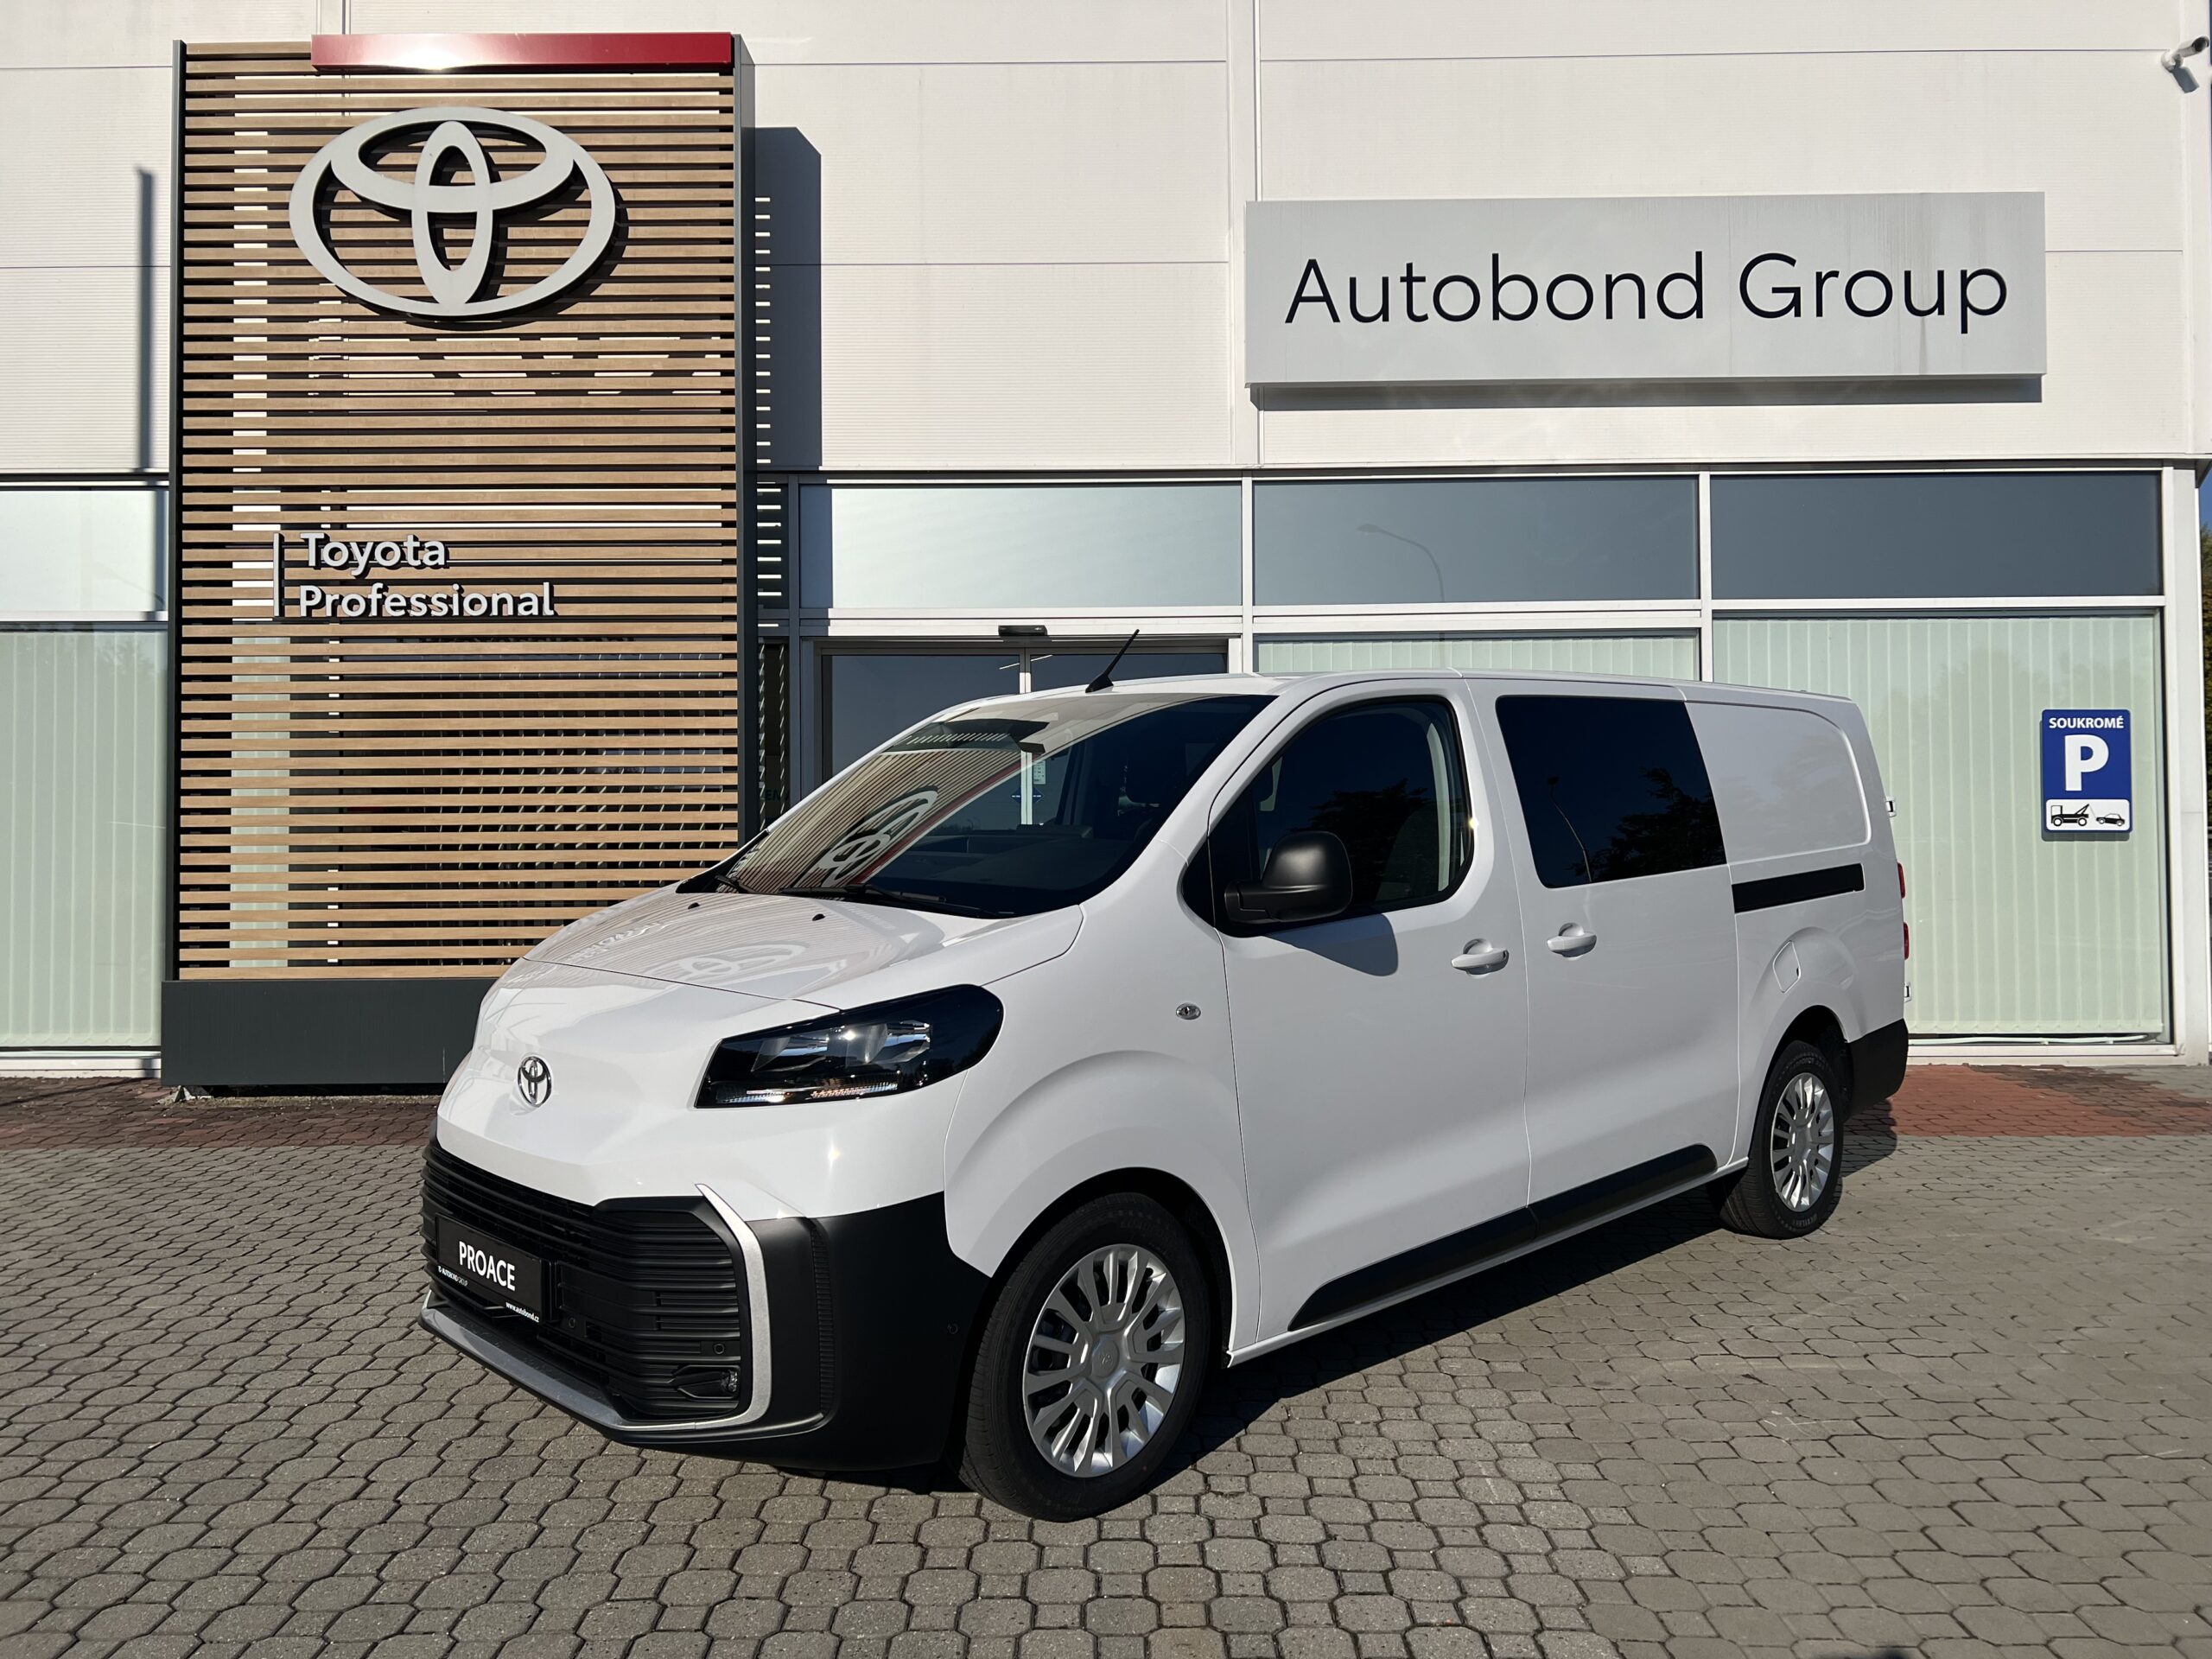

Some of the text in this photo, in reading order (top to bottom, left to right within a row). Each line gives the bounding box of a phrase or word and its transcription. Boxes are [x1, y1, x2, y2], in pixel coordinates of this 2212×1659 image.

[1285, 251, 2007, 334] Autobond Group
[300, 532, 447, 577] Toyota
[300, 582, 555, 617] Professional
[2049, 715, 2125, 729] SOUKROMÉ
[2064, 734, 2109, 791] P
[458, 1240, 517, 1292] PROACE
